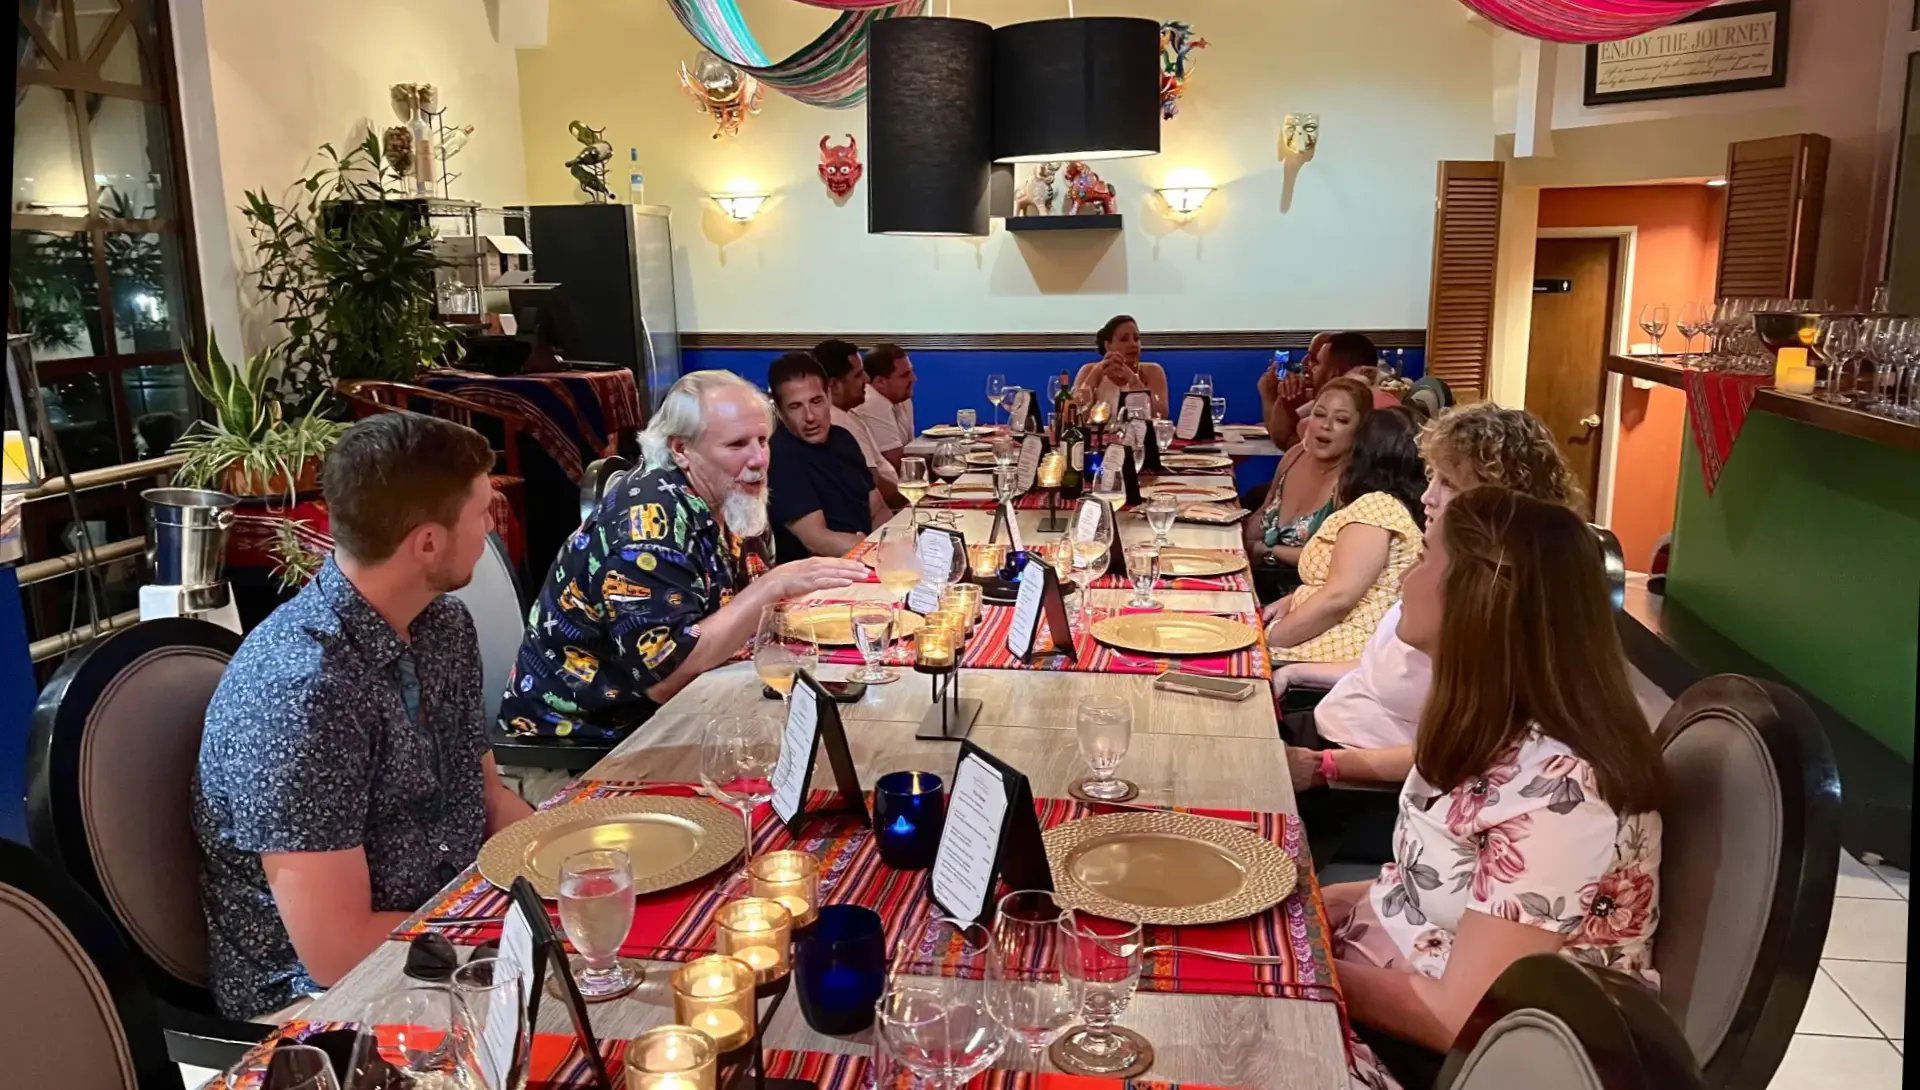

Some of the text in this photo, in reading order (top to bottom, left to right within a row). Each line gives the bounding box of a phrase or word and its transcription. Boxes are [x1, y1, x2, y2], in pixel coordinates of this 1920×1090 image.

[1601, 21, 1772, 60] ENJOY THE JOURNEY
